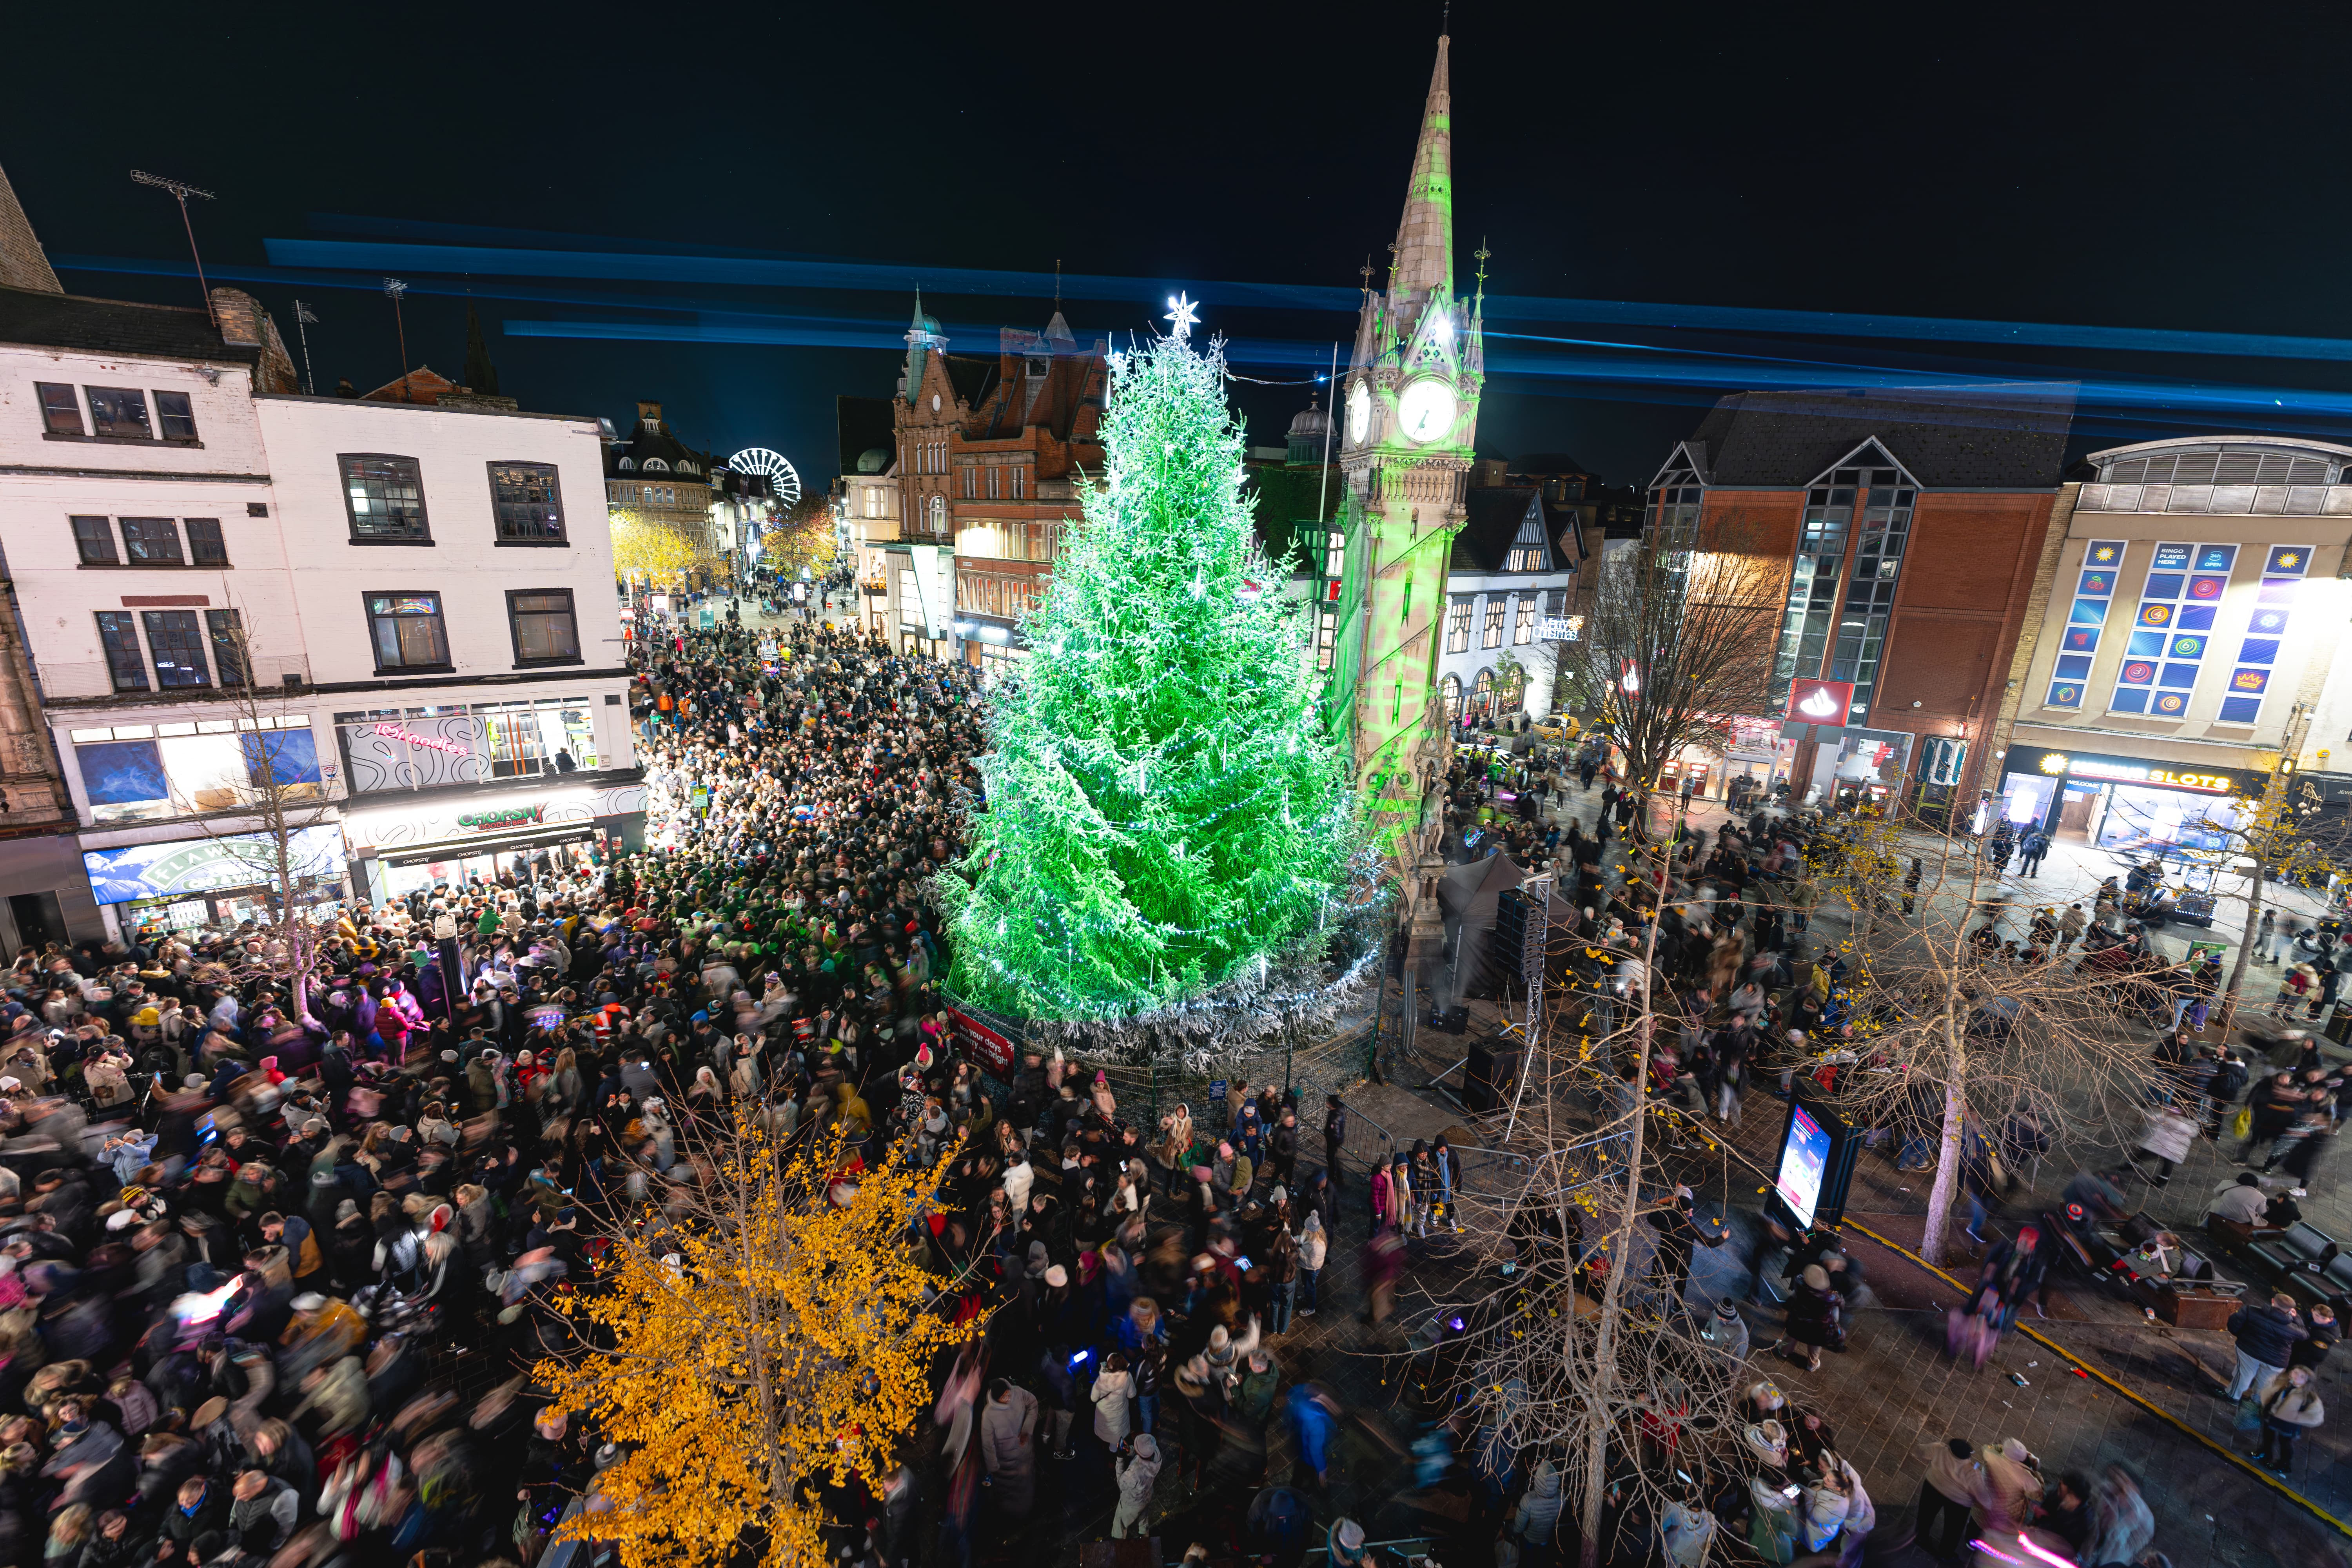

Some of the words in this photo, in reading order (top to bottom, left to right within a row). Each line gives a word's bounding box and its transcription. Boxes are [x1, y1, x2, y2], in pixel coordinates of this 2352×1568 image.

[1541, 617, 1569, 631] Merry
[2067, 779, 2100, 788] WELCOME
[2149, 769, 2230, 789] SLOTS
[458, 801, 548, 827] CHOPSTIX
[479, 820, 511, 830] NOODLE
[559, 835, 583, 844] CHOPSTIX
[155, 844, 292, 880] FLAWLES
[403, 856, 430, 864] CHOPSTIX
[188, 879, 217, 889] CBD
[220, 875, 232, 885] &
[234, 871, 267, 883] VAPE
[959, 1024, 969, 1034] May
[969, 1029, 984, 1042] your
[984, 1038, 1002, 1053] days
[959, 1032, 978, 1049] merry
[979, 1046, 987, 1054] and
[988, 1048, 1009, 1067] bright
